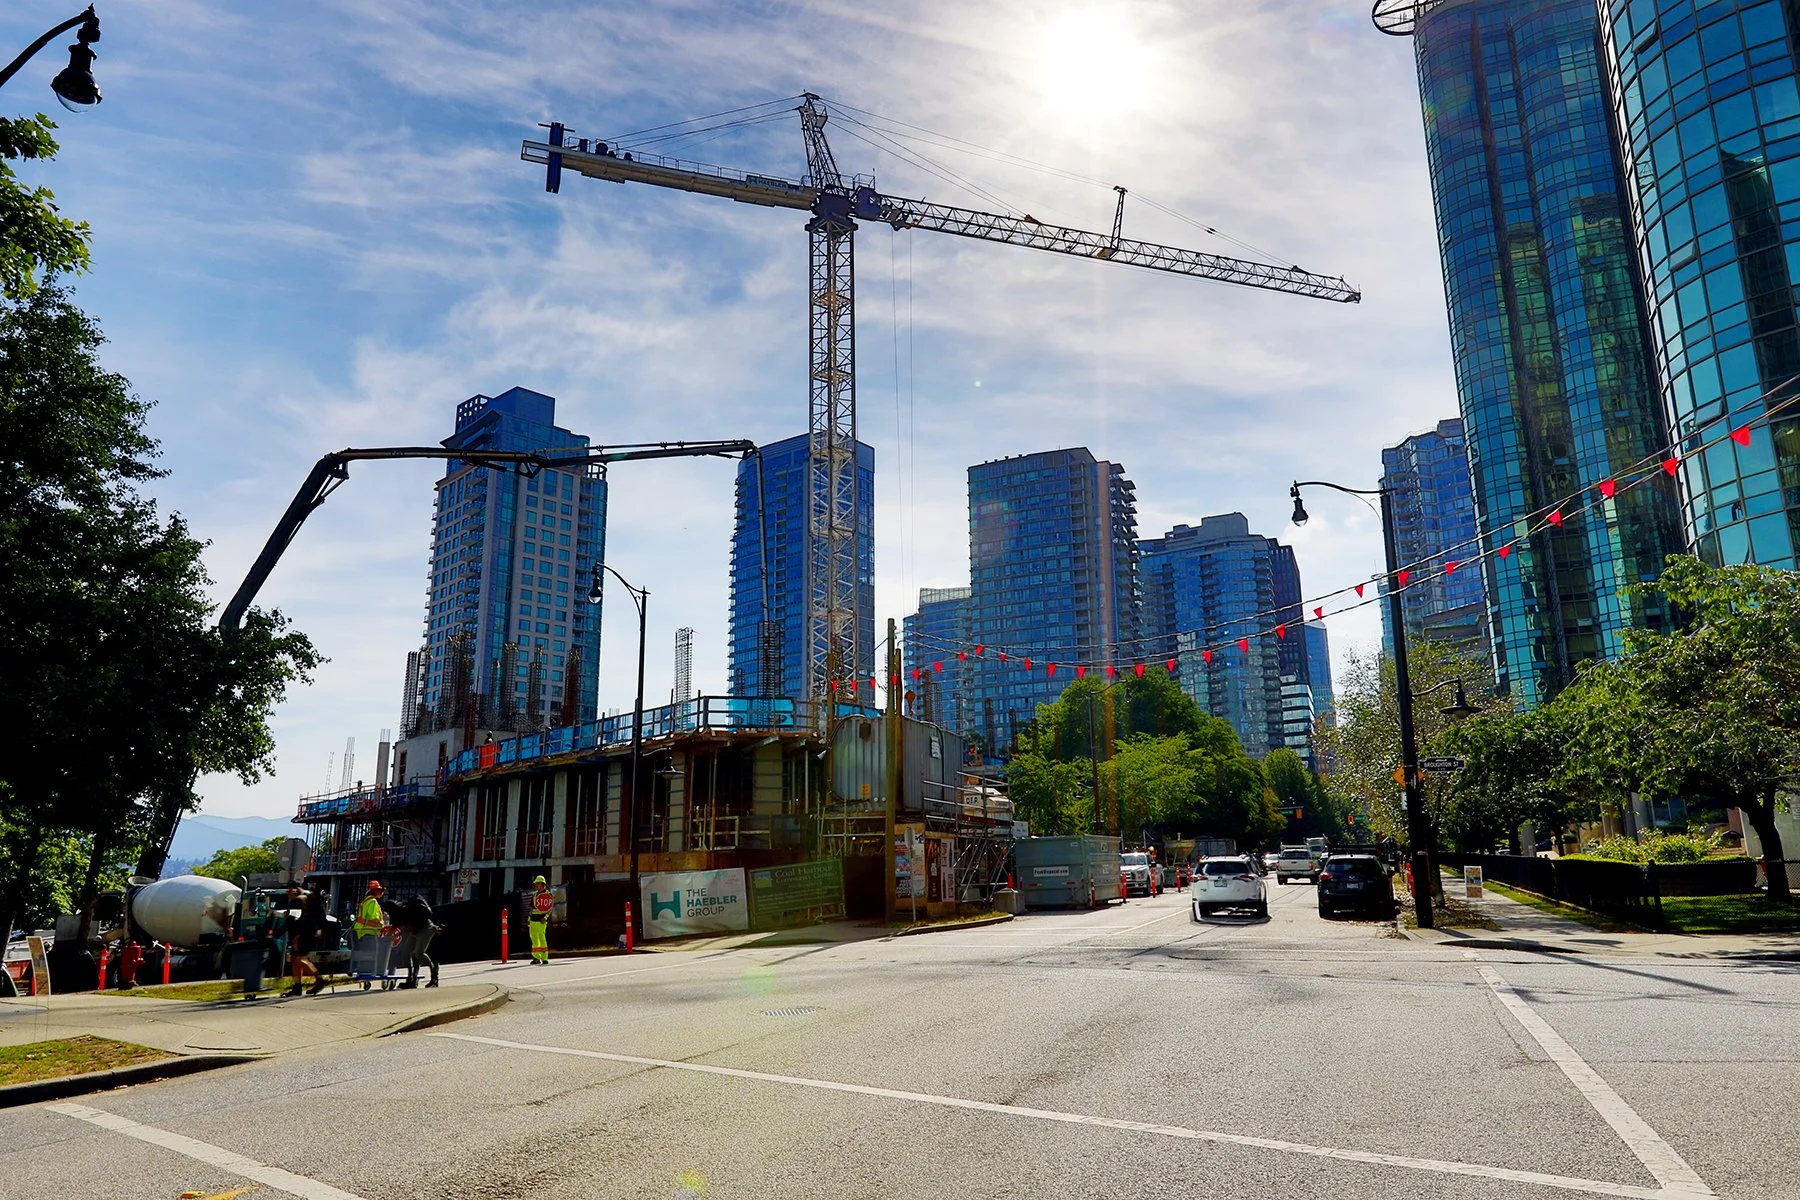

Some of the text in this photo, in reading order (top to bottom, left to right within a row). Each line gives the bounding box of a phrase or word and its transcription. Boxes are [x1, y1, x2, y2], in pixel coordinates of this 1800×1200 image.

[758, 179, 787, 188] HAEBLER
[775, 868, 795, 879] Coal
[686, 888, 707, 898] THE
[536, 898, 553, 907] STOP
[686, 895, 737, 908] HAEBLER
[686, 906, 725, 918] GROUP
